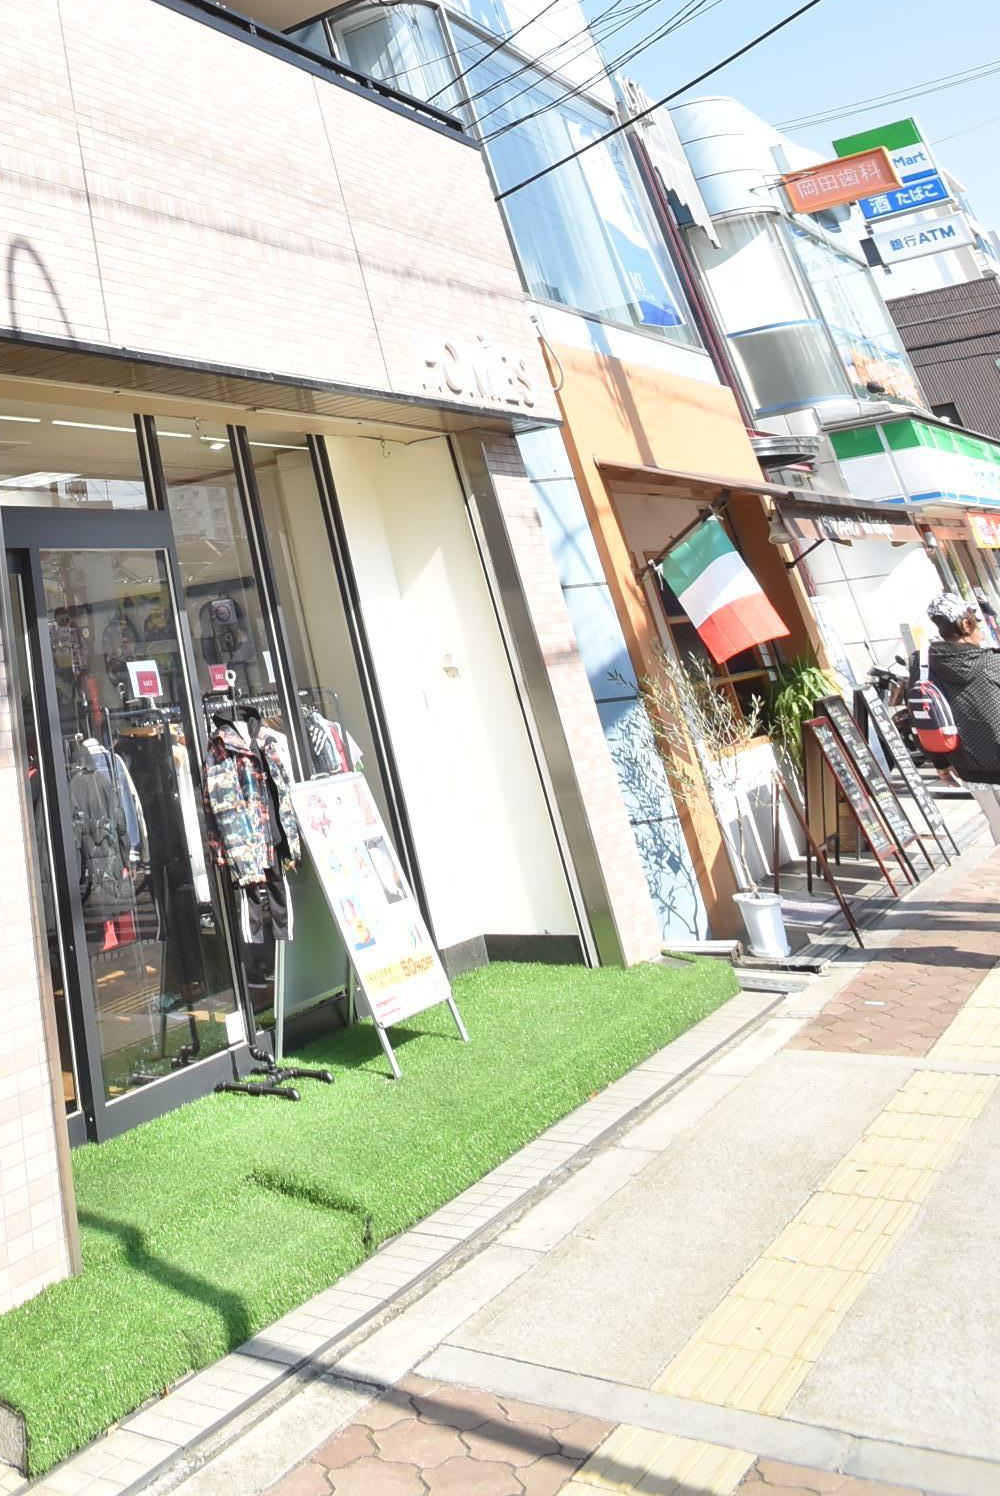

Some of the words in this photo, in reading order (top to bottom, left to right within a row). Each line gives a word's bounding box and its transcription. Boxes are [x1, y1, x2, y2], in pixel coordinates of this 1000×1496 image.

[797, 159, 882, 200] 岡田歯科
[867, 195, 892, 215] 酒
[894, 183, 940, 206] たばこ
[889, 224, 956, 252] 銀行ATM
